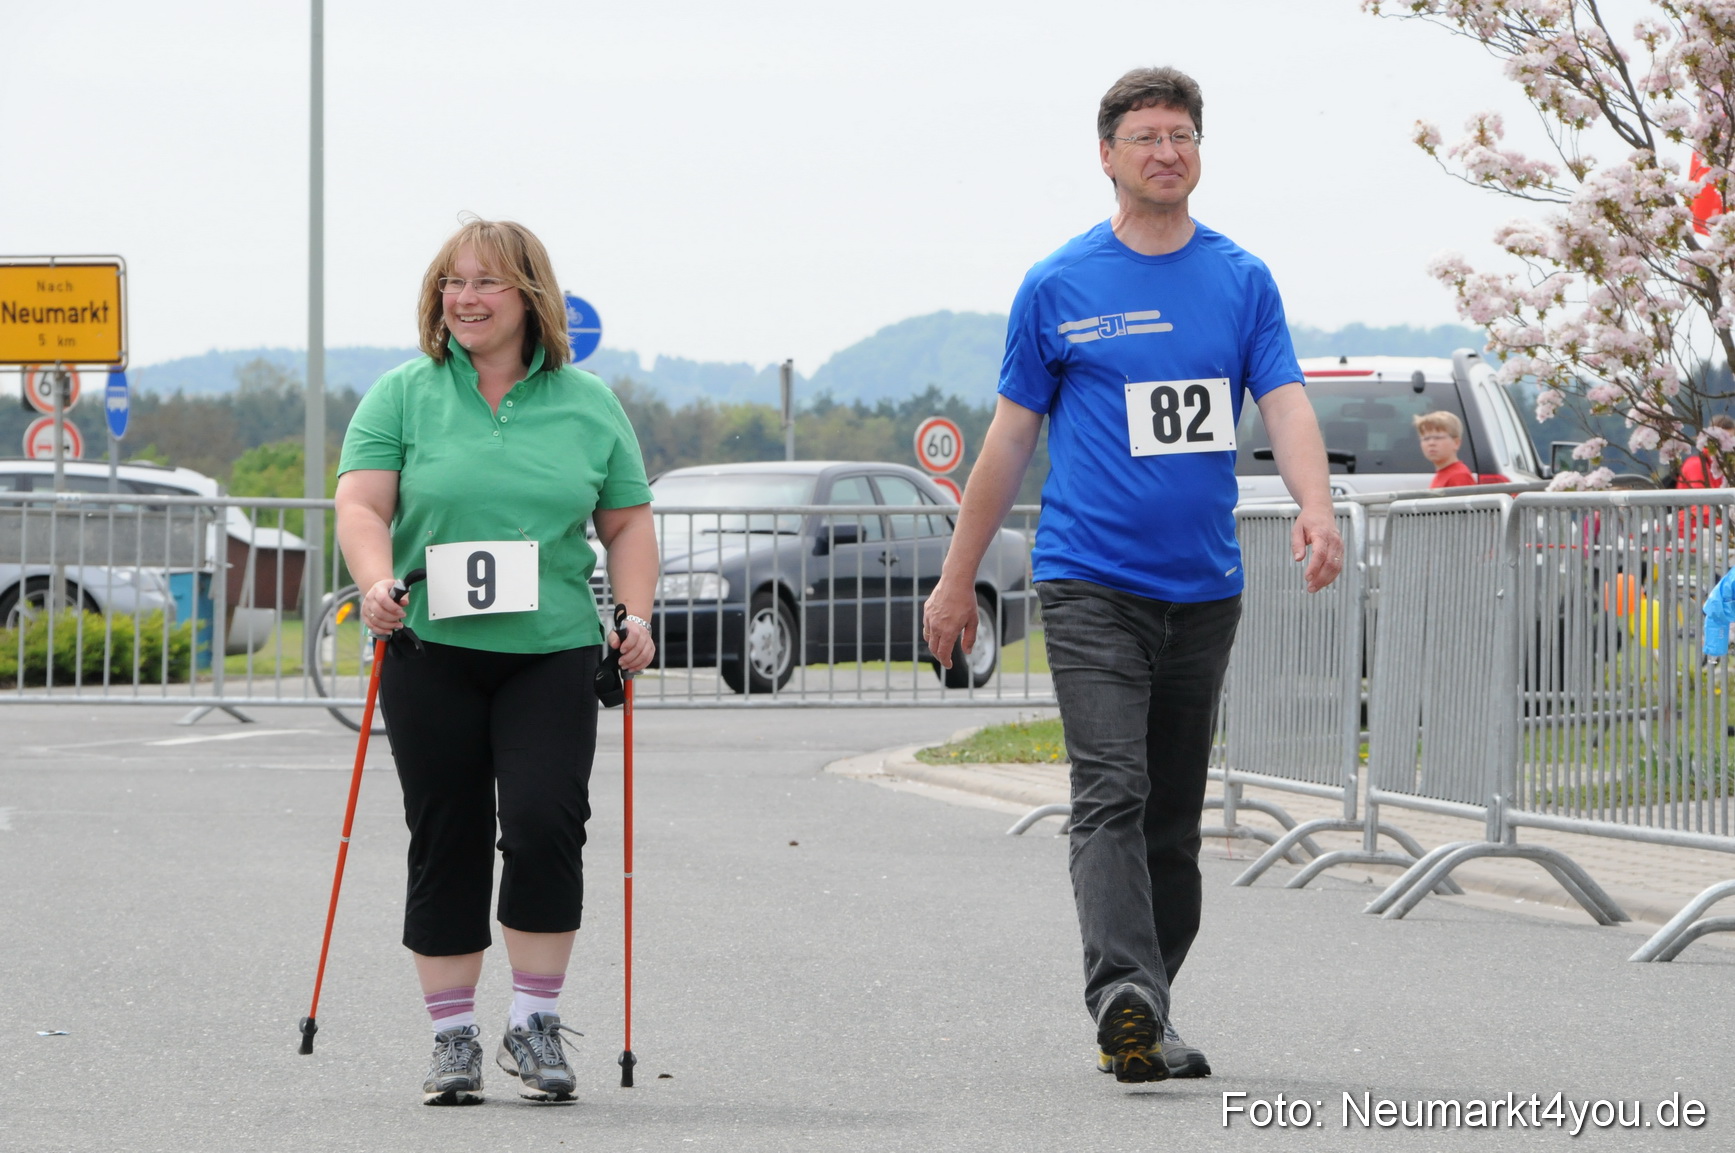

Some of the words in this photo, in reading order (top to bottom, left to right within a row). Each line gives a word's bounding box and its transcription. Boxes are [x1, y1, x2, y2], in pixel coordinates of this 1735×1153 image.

[36, 280, 74, 293] Nach
[1, 300, 109, 324] Neumarkt
[38, 333, 46, 346] 5
[57, 335, 77, 347] km
[1150, 384, 1214, 444] 82
[927, 434, 952, 457] 60
[466, 550, 496, 610] 9
